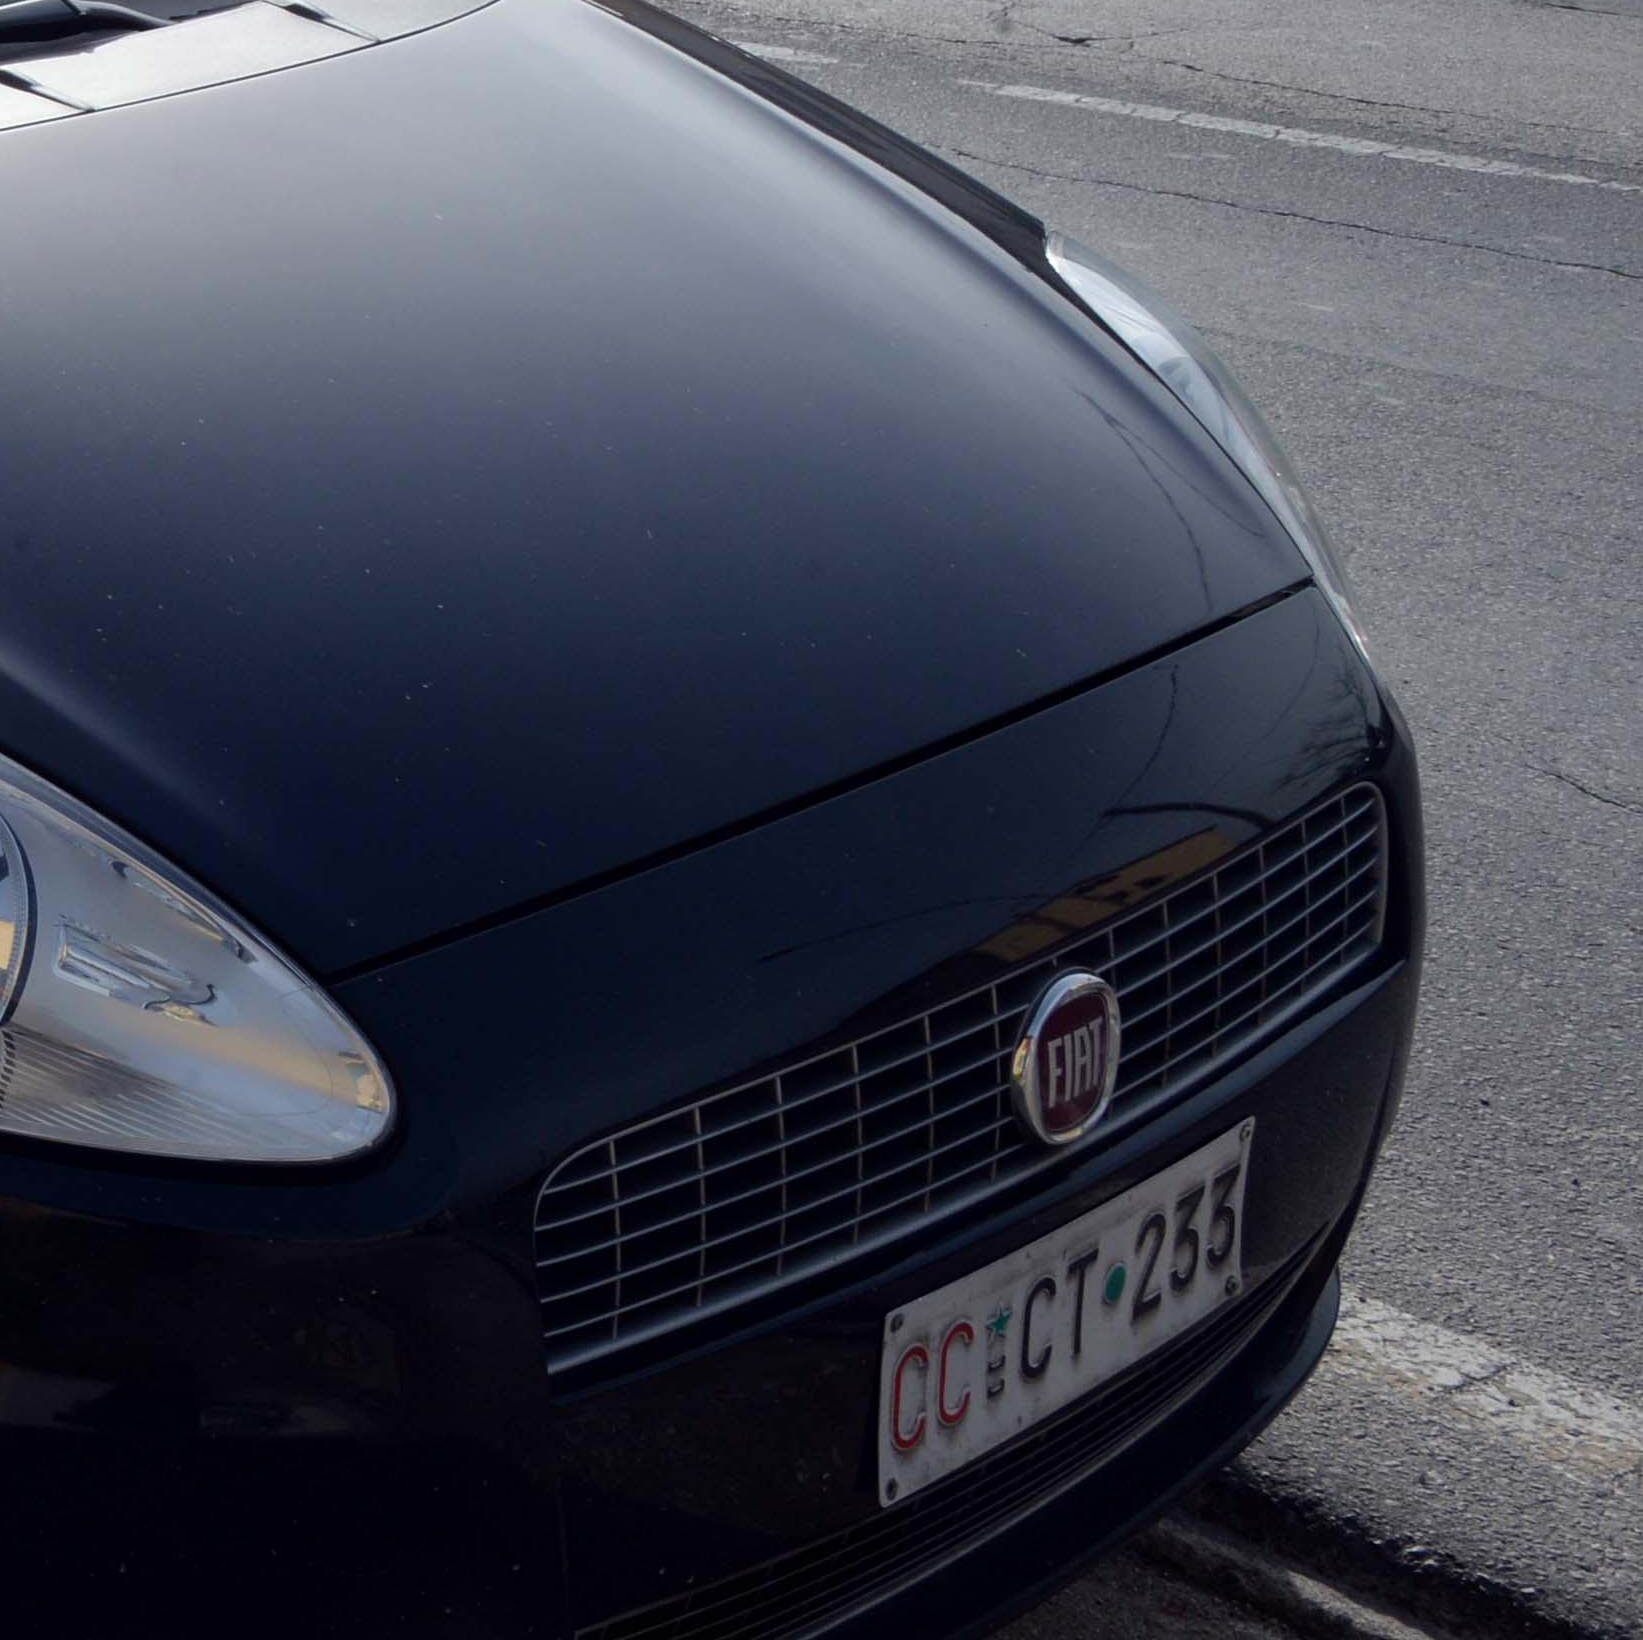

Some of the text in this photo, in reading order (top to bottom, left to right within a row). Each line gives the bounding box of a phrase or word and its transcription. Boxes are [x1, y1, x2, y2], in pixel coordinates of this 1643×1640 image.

[1046, 1015, 1104, 1109] FIAT
[890, 1319, 976, 1452] CC
[1018, 1244, 1100, 1381] CT
[1130, 1161, 1242, 1328] 233
